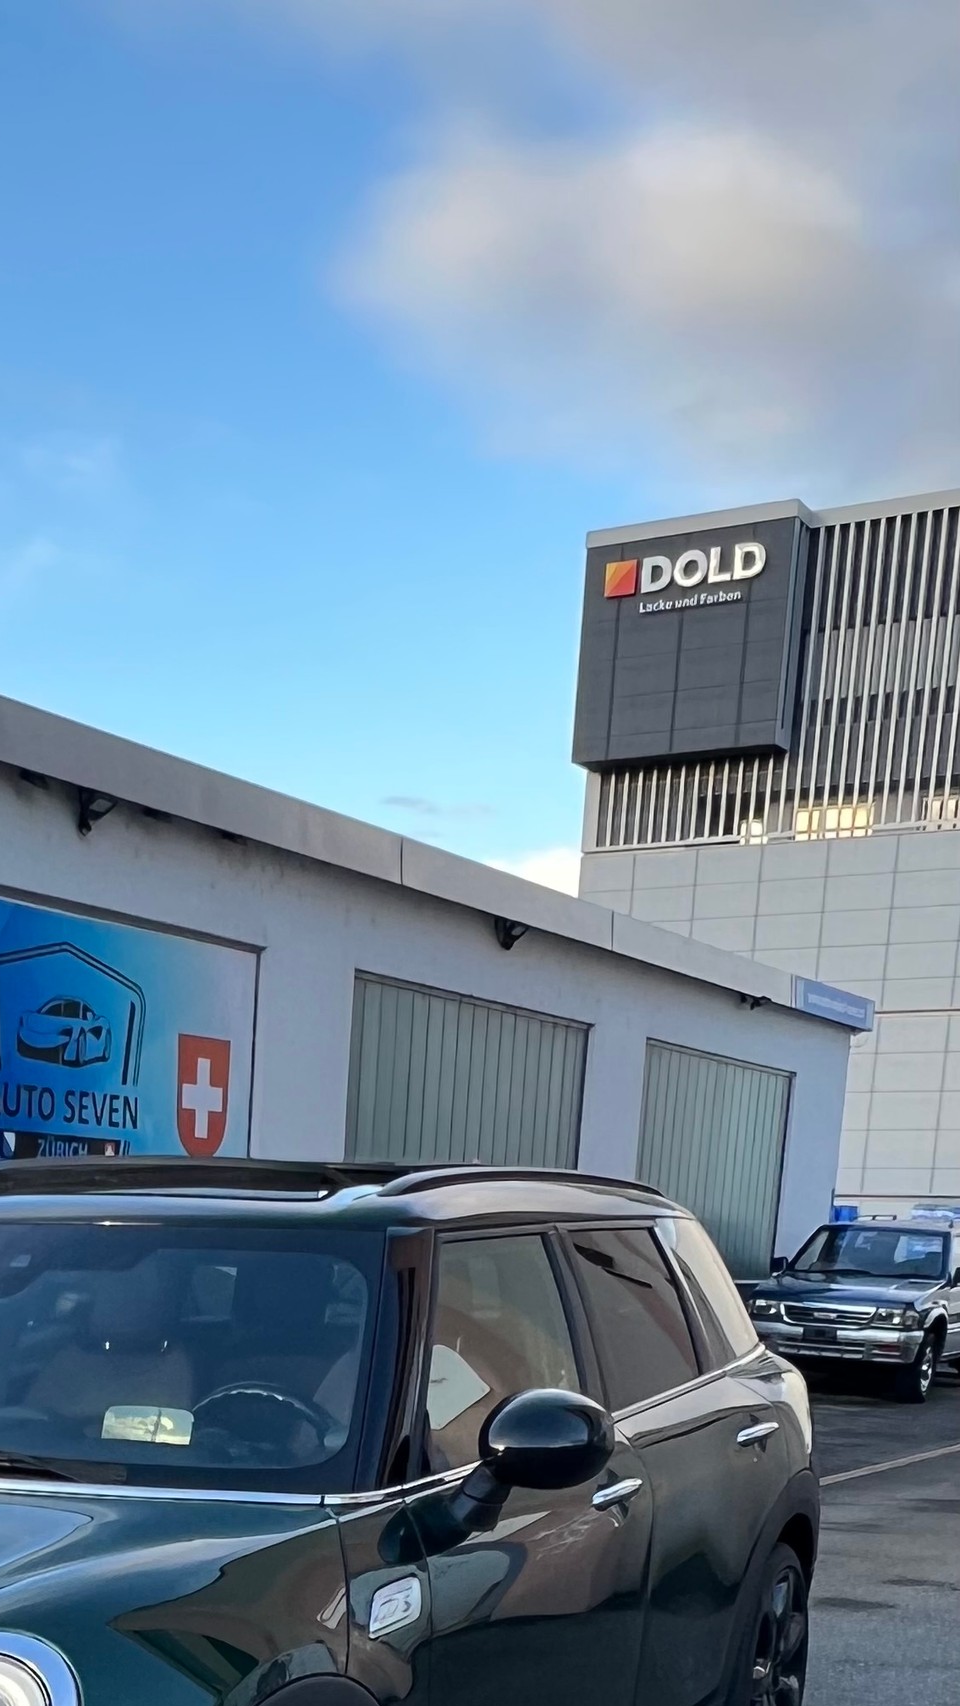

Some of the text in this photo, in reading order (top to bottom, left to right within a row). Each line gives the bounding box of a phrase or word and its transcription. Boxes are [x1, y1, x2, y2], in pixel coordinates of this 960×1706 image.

[640, 541, 767, 594] DOLD
[674, 594, 698, 610] und
[62, 1089, 139, 1130] SEVEN
[37, 1136, 88, 1159] ZÜRICH
